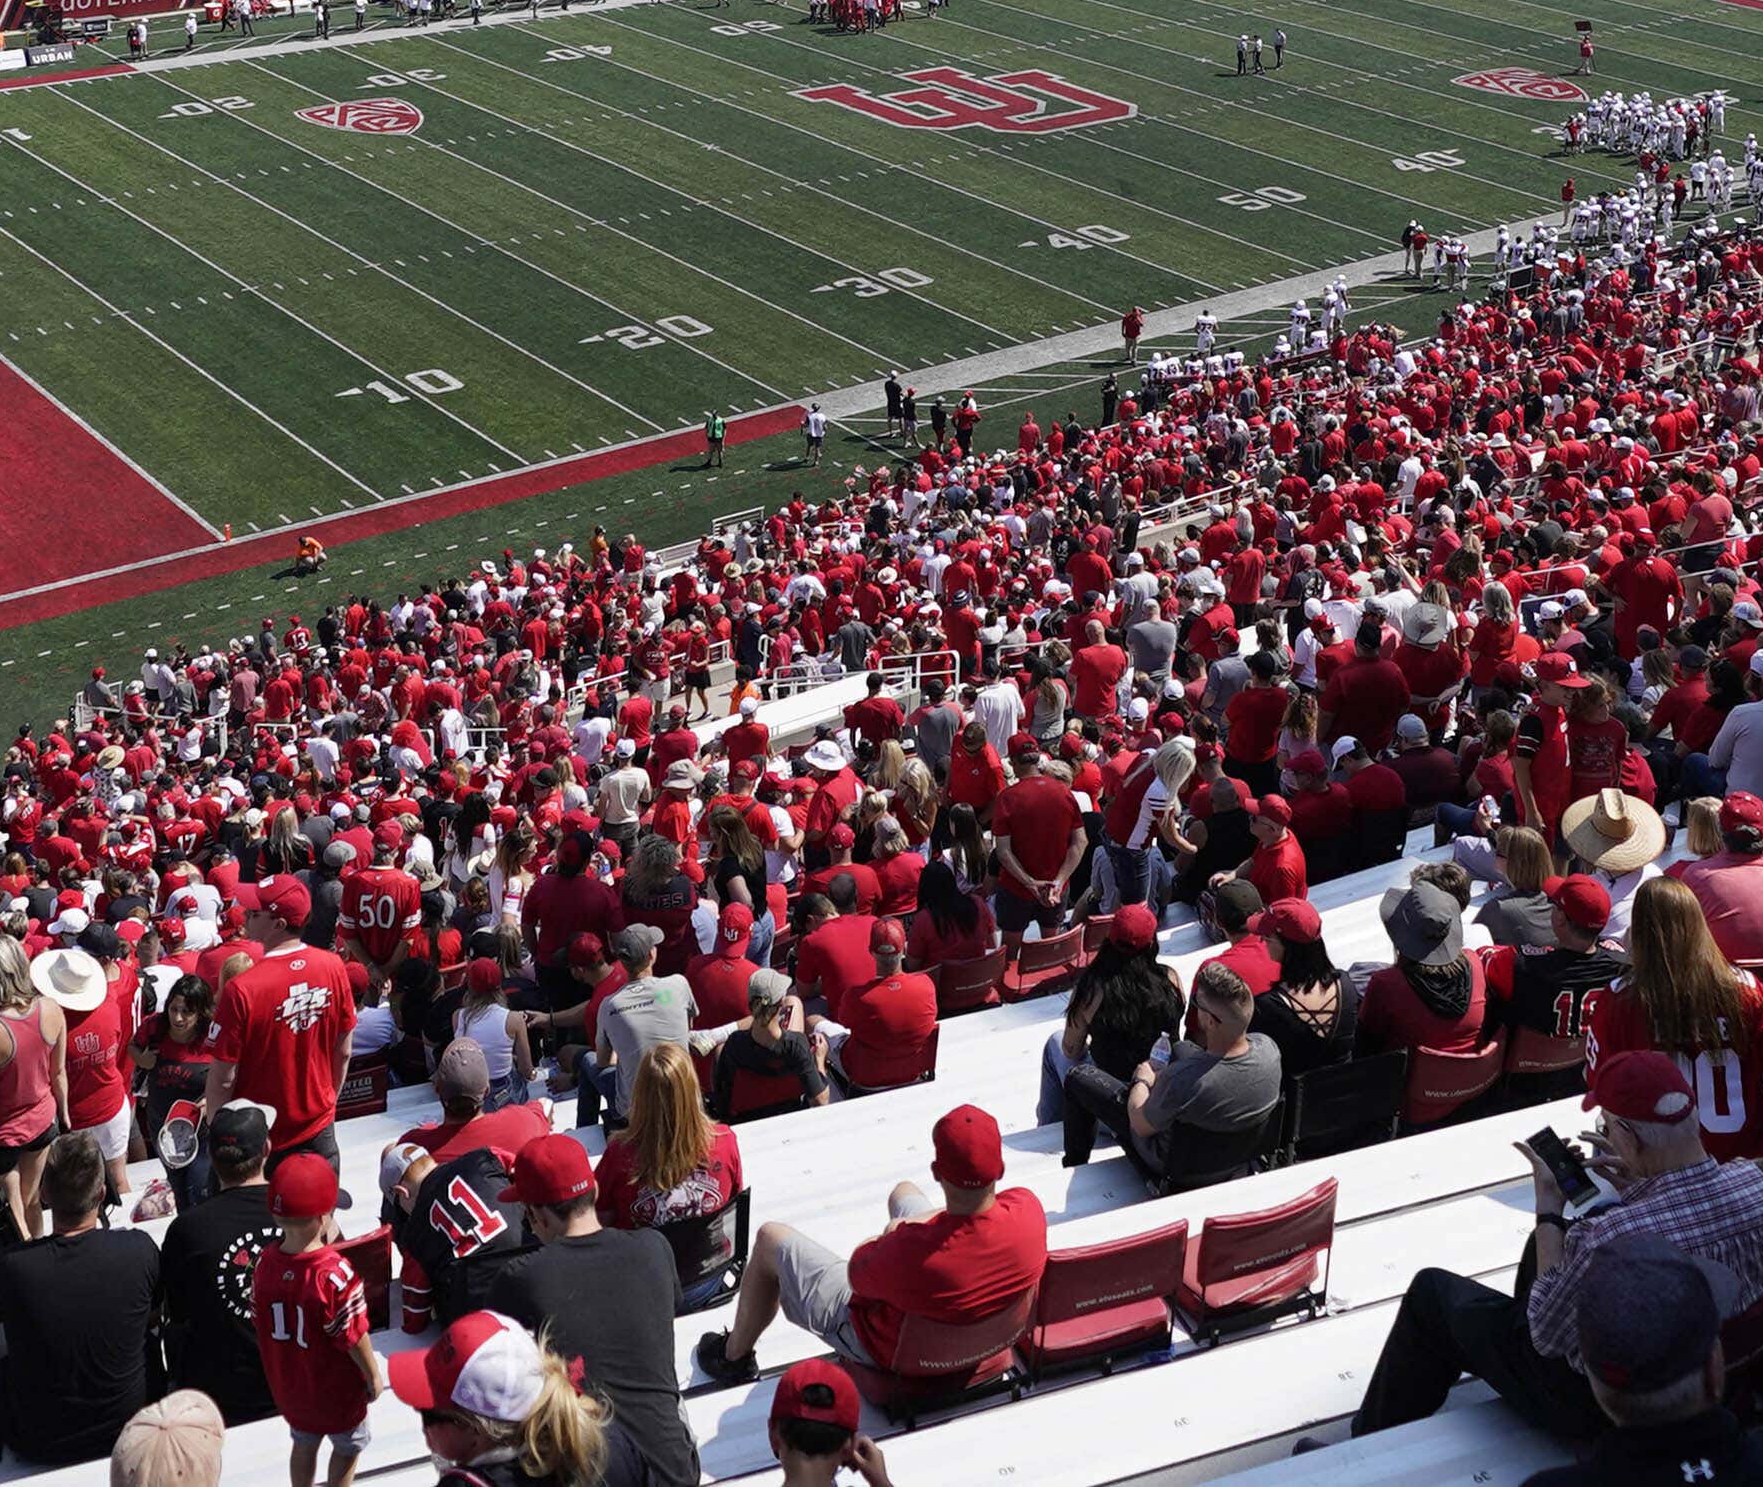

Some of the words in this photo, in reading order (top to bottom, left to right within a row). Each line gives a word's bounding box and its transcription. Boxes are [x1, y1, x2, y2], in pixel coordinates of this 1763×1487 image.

[710, 21, 784, 36] 50
[32, 52, 73, 63] URBAN
[545, 46, 612, 60] 40
[366, 69, 447, 87] 30
[171, 96, 256, 116] 20
[1391, 152, 1467, 173] 40
[1216, 187, 1308, 211] 50
[1048, 225, 1132, 250] 40
[833, 267, 935, 297] 30
[605, 315, 715, 350] 20
[366, 369, 465, 404] 10
[292, 632, 310, 651] 13
[177, 833, 198, 855] 17
[358, 894, 396, 929] 50
[429, 1174, 508, 1259] 11
[328, 1257, 355, 1292] 11
[271, 1302, 309, 1349] 11
